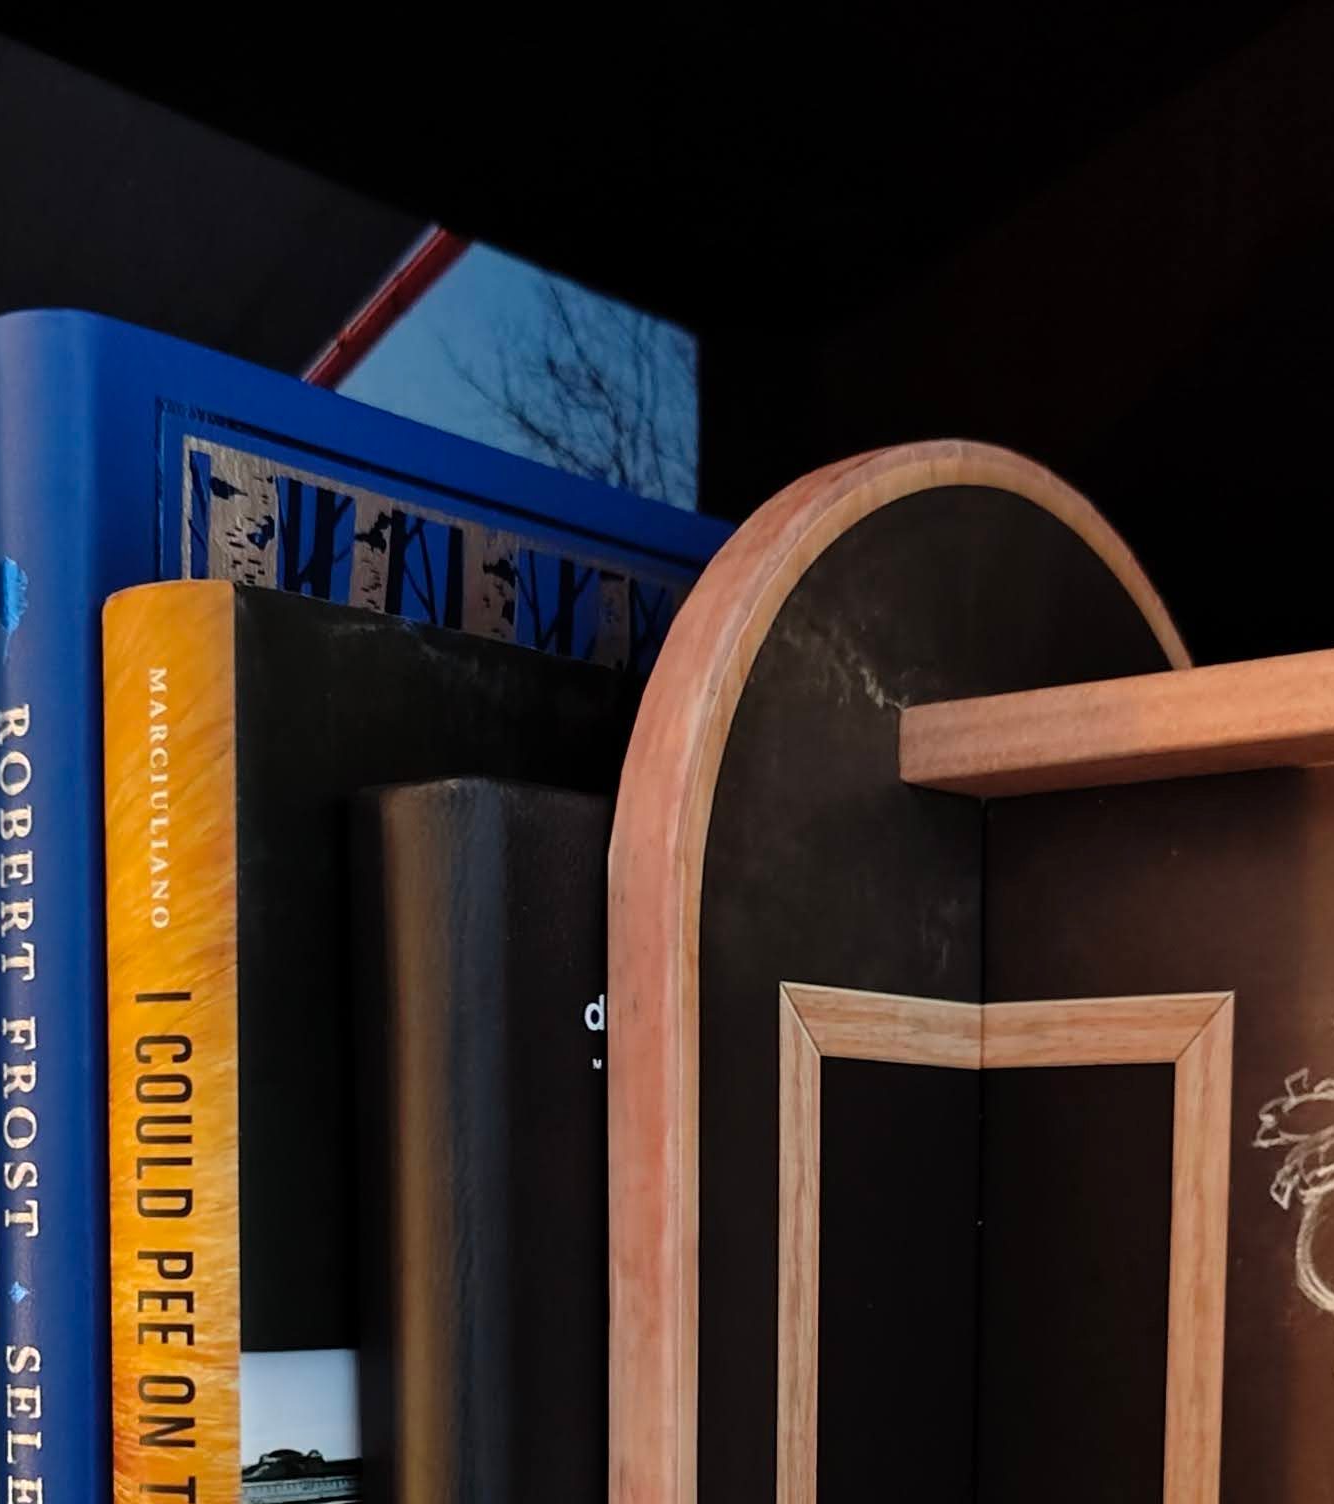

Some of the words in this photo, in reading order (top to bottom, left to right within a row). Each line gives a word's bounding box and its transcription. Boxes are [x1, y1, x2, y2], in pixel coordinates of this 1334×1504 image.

[0, 704, 34, 980] ROBERT
[149, 669, 169, 928] MARCIULIANO
[136, 992, 191, 1002] I
[3, 1017, 38, 1237] FROST
[136, 1035, 193, 1218] COULD
[138, 1252, 194, 1346] PEE
[139, 1376, 196, 1447] ON
